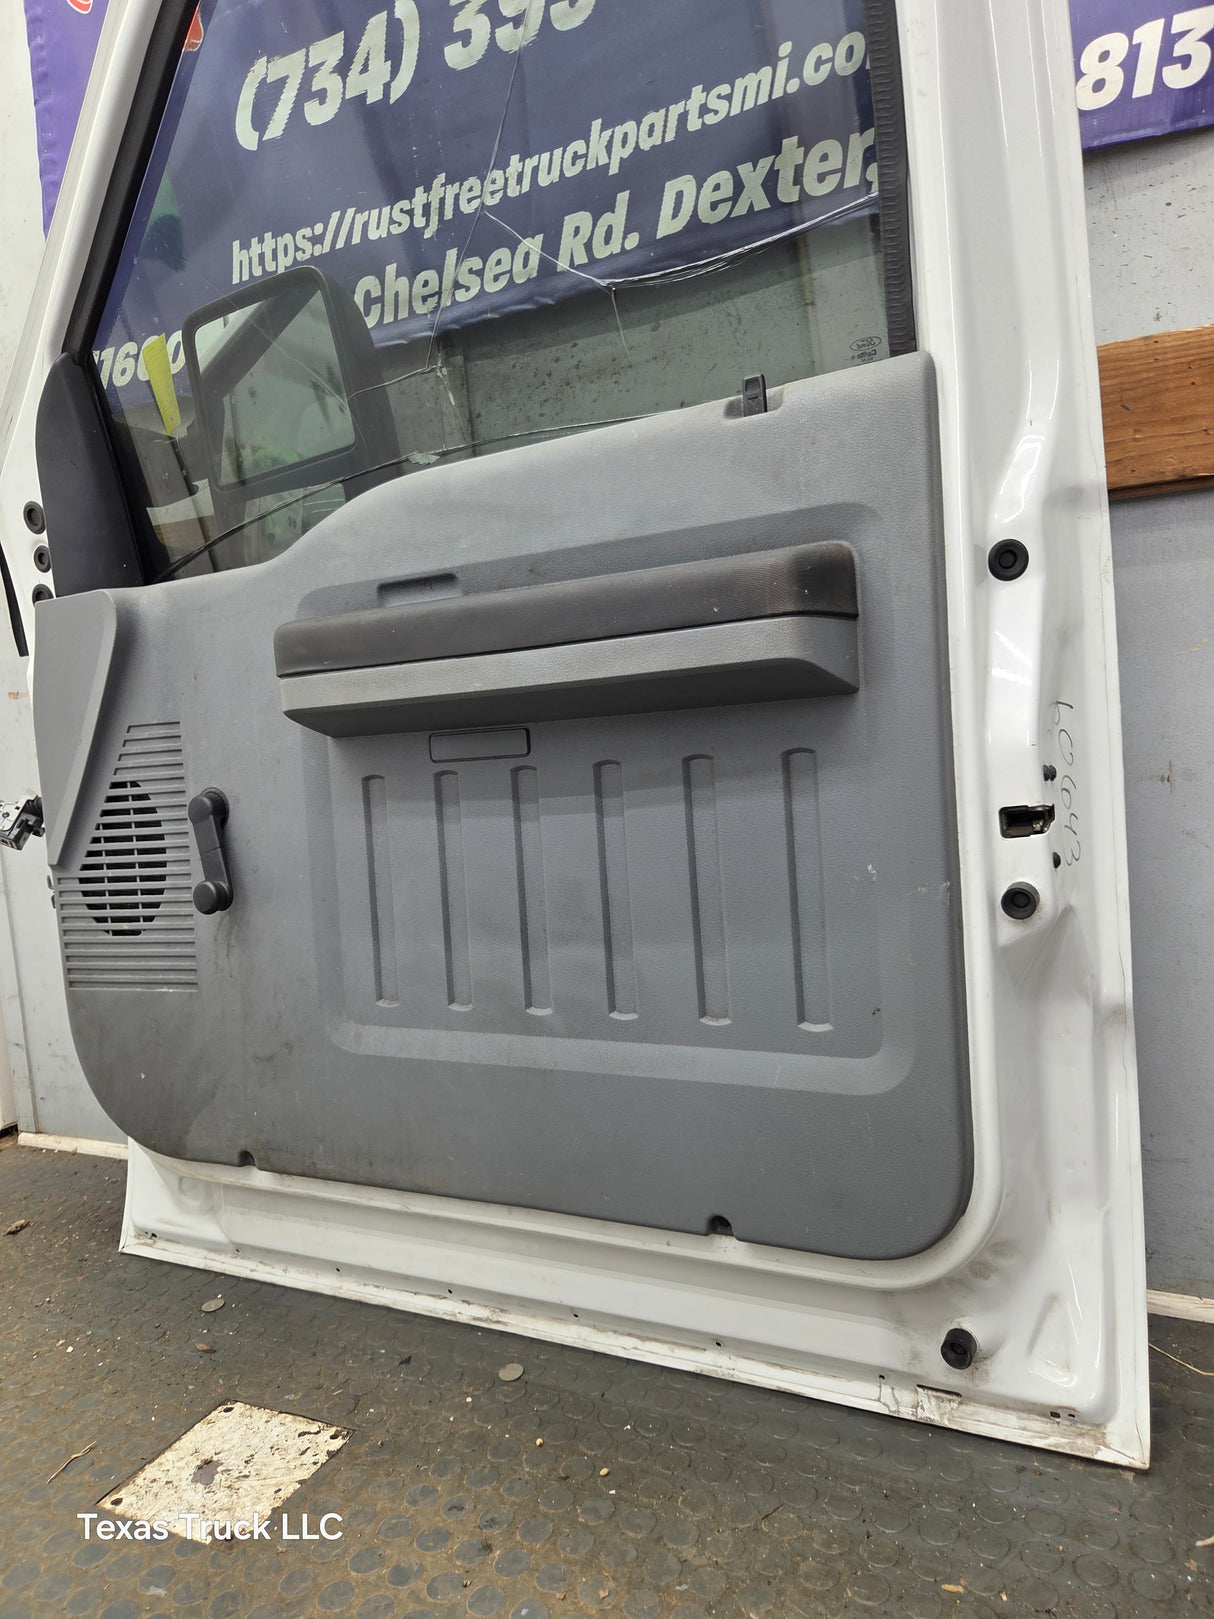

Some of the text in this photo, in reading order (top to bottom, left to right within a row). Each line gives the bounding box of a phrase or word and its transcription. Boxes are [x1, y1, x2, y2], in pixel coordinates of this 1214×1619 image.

[232, 31, 871, 284] https://rustfreetruckpartsmi.co
[235, 0, 420, 150] (734)
[353, 233, 544, 328] Chelsea
[557, 190, 639, 272] Rd.
[656, 127, 879, 240] Dexter,
[1075, 4, 1214, 111] 813
